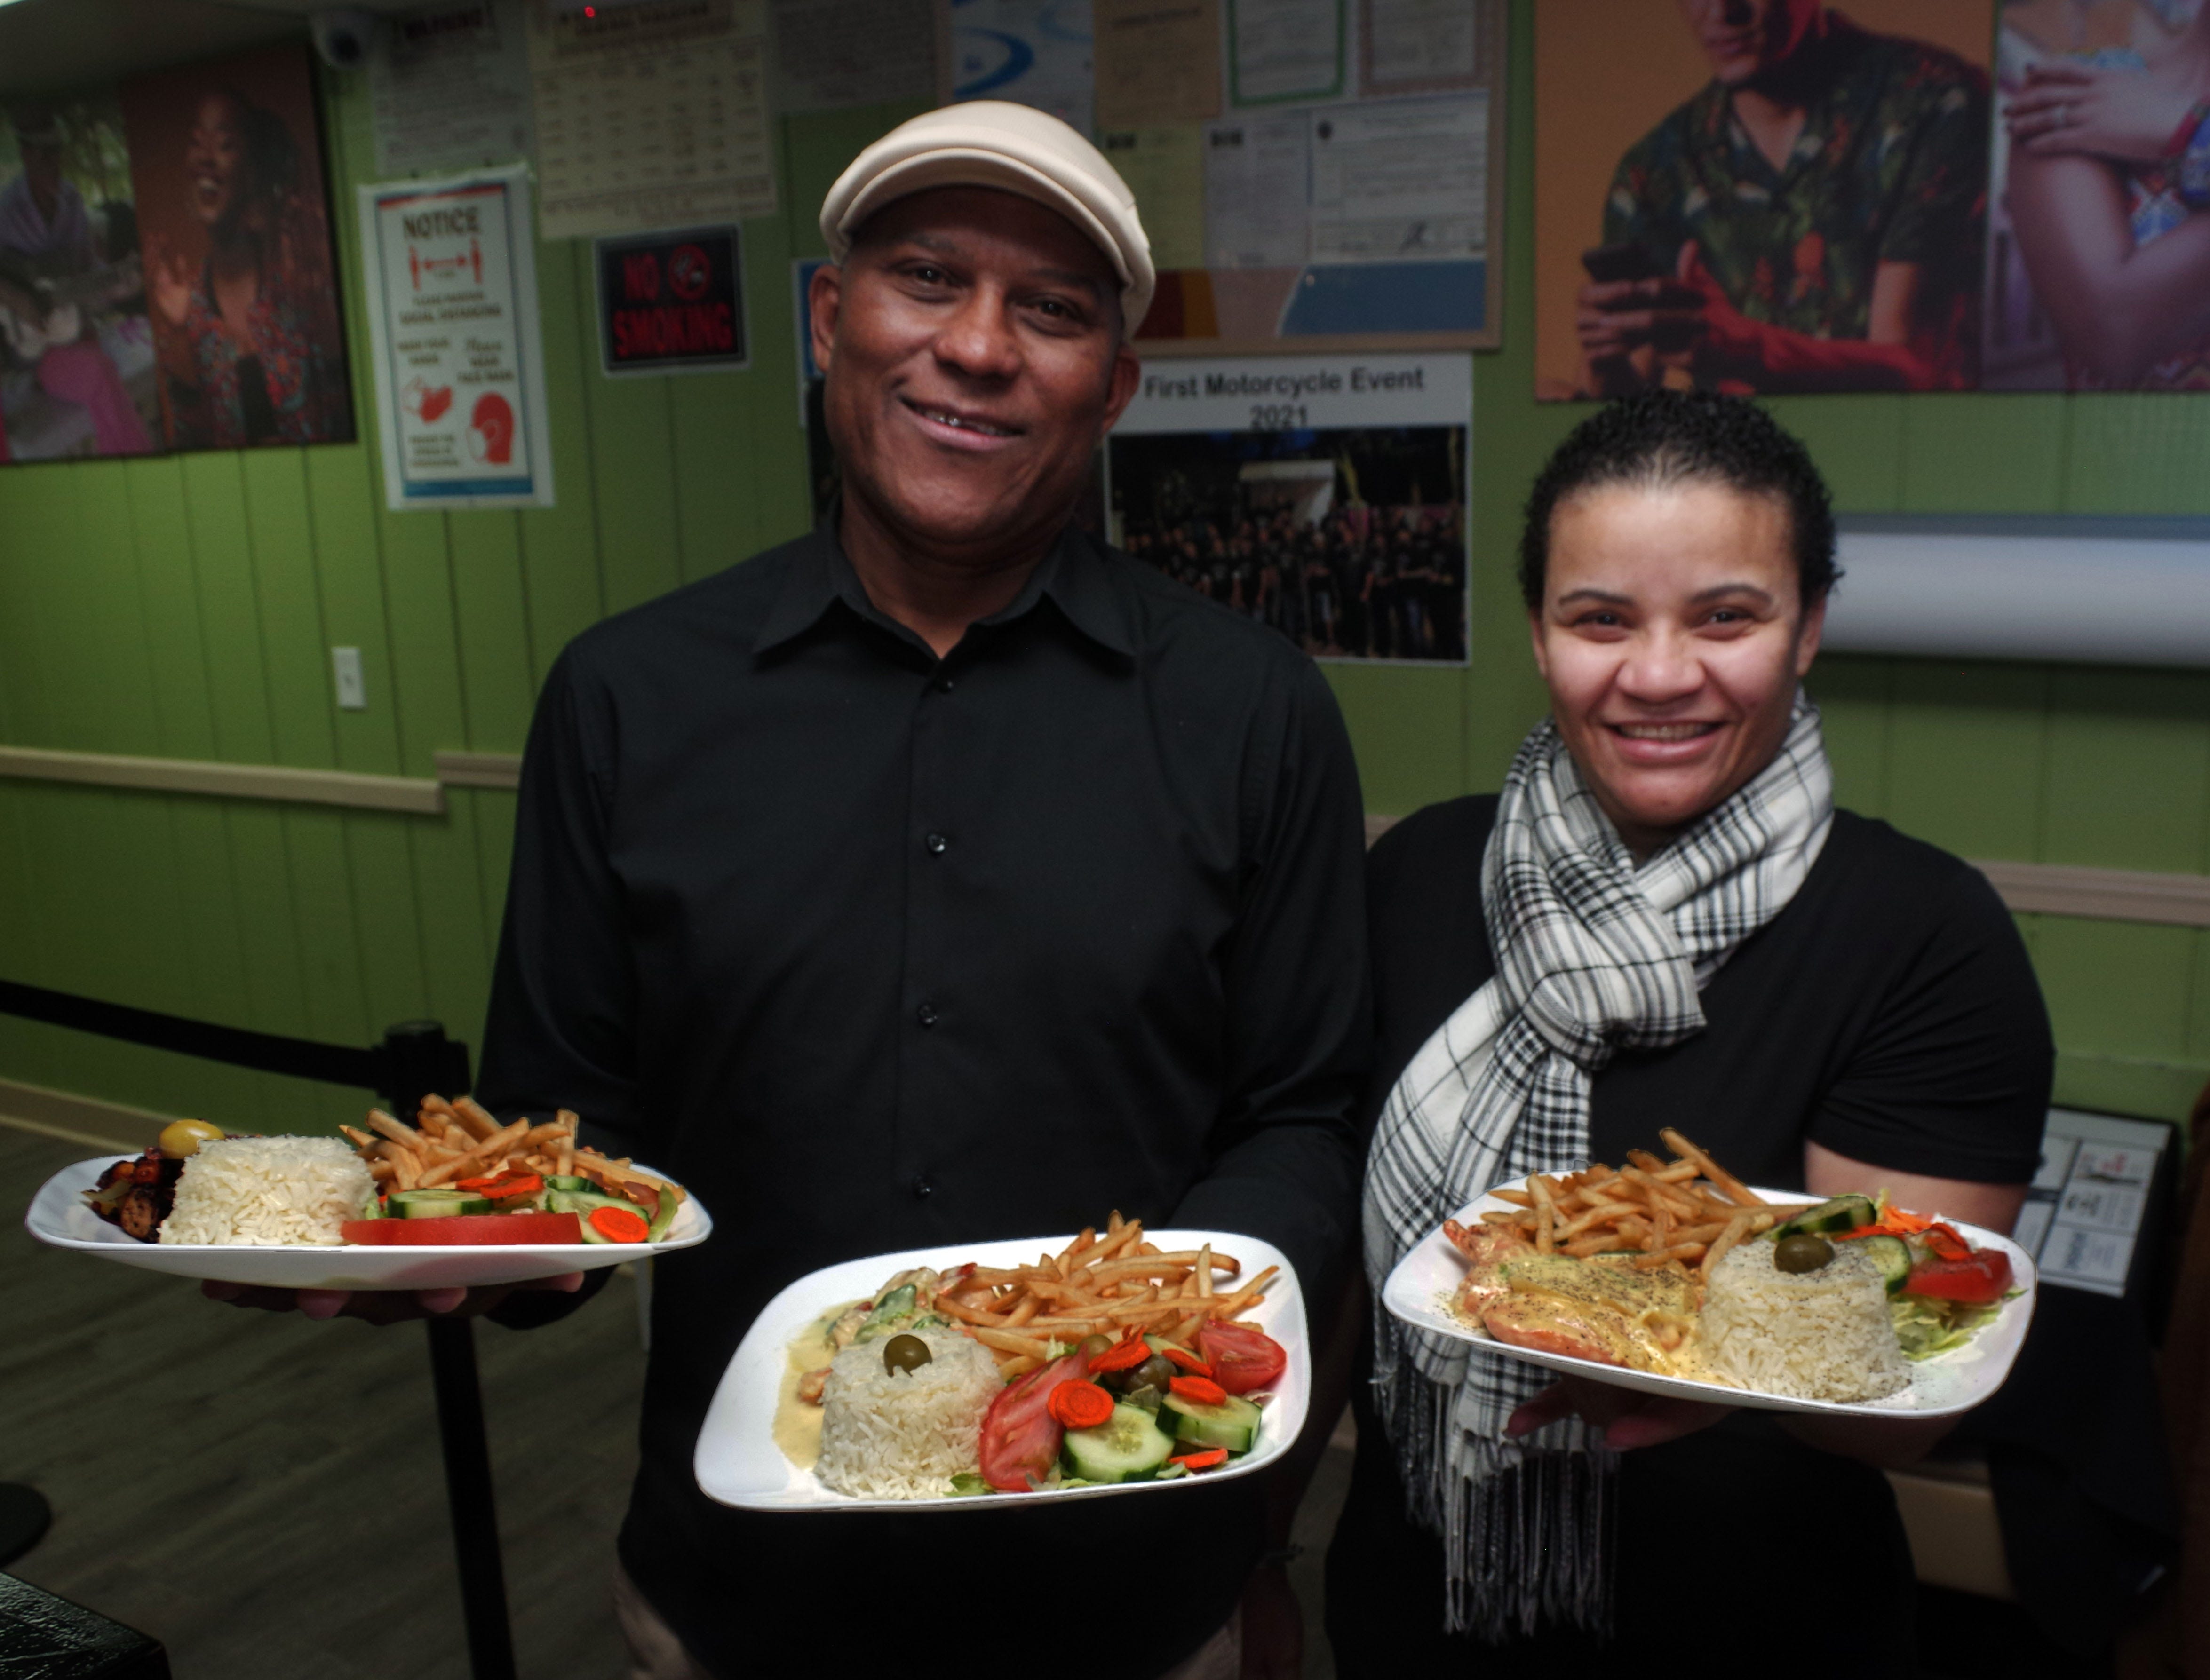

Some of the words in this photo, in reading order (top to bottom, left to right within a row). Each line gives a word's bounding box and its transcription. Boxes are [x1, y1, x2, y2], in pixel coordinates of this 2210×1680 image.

[403, 206, 480, 238] NOTICE
[623, 253, 659, 301] NO
[614, 303, 732, 357] SMOKING
[1145, 375, 1198, 399] First
[1205, 369, 1341, 398] Motorcycle
[1351, 366, 1424, 391] Event
[1250, 404, 1308, 429] 2021
